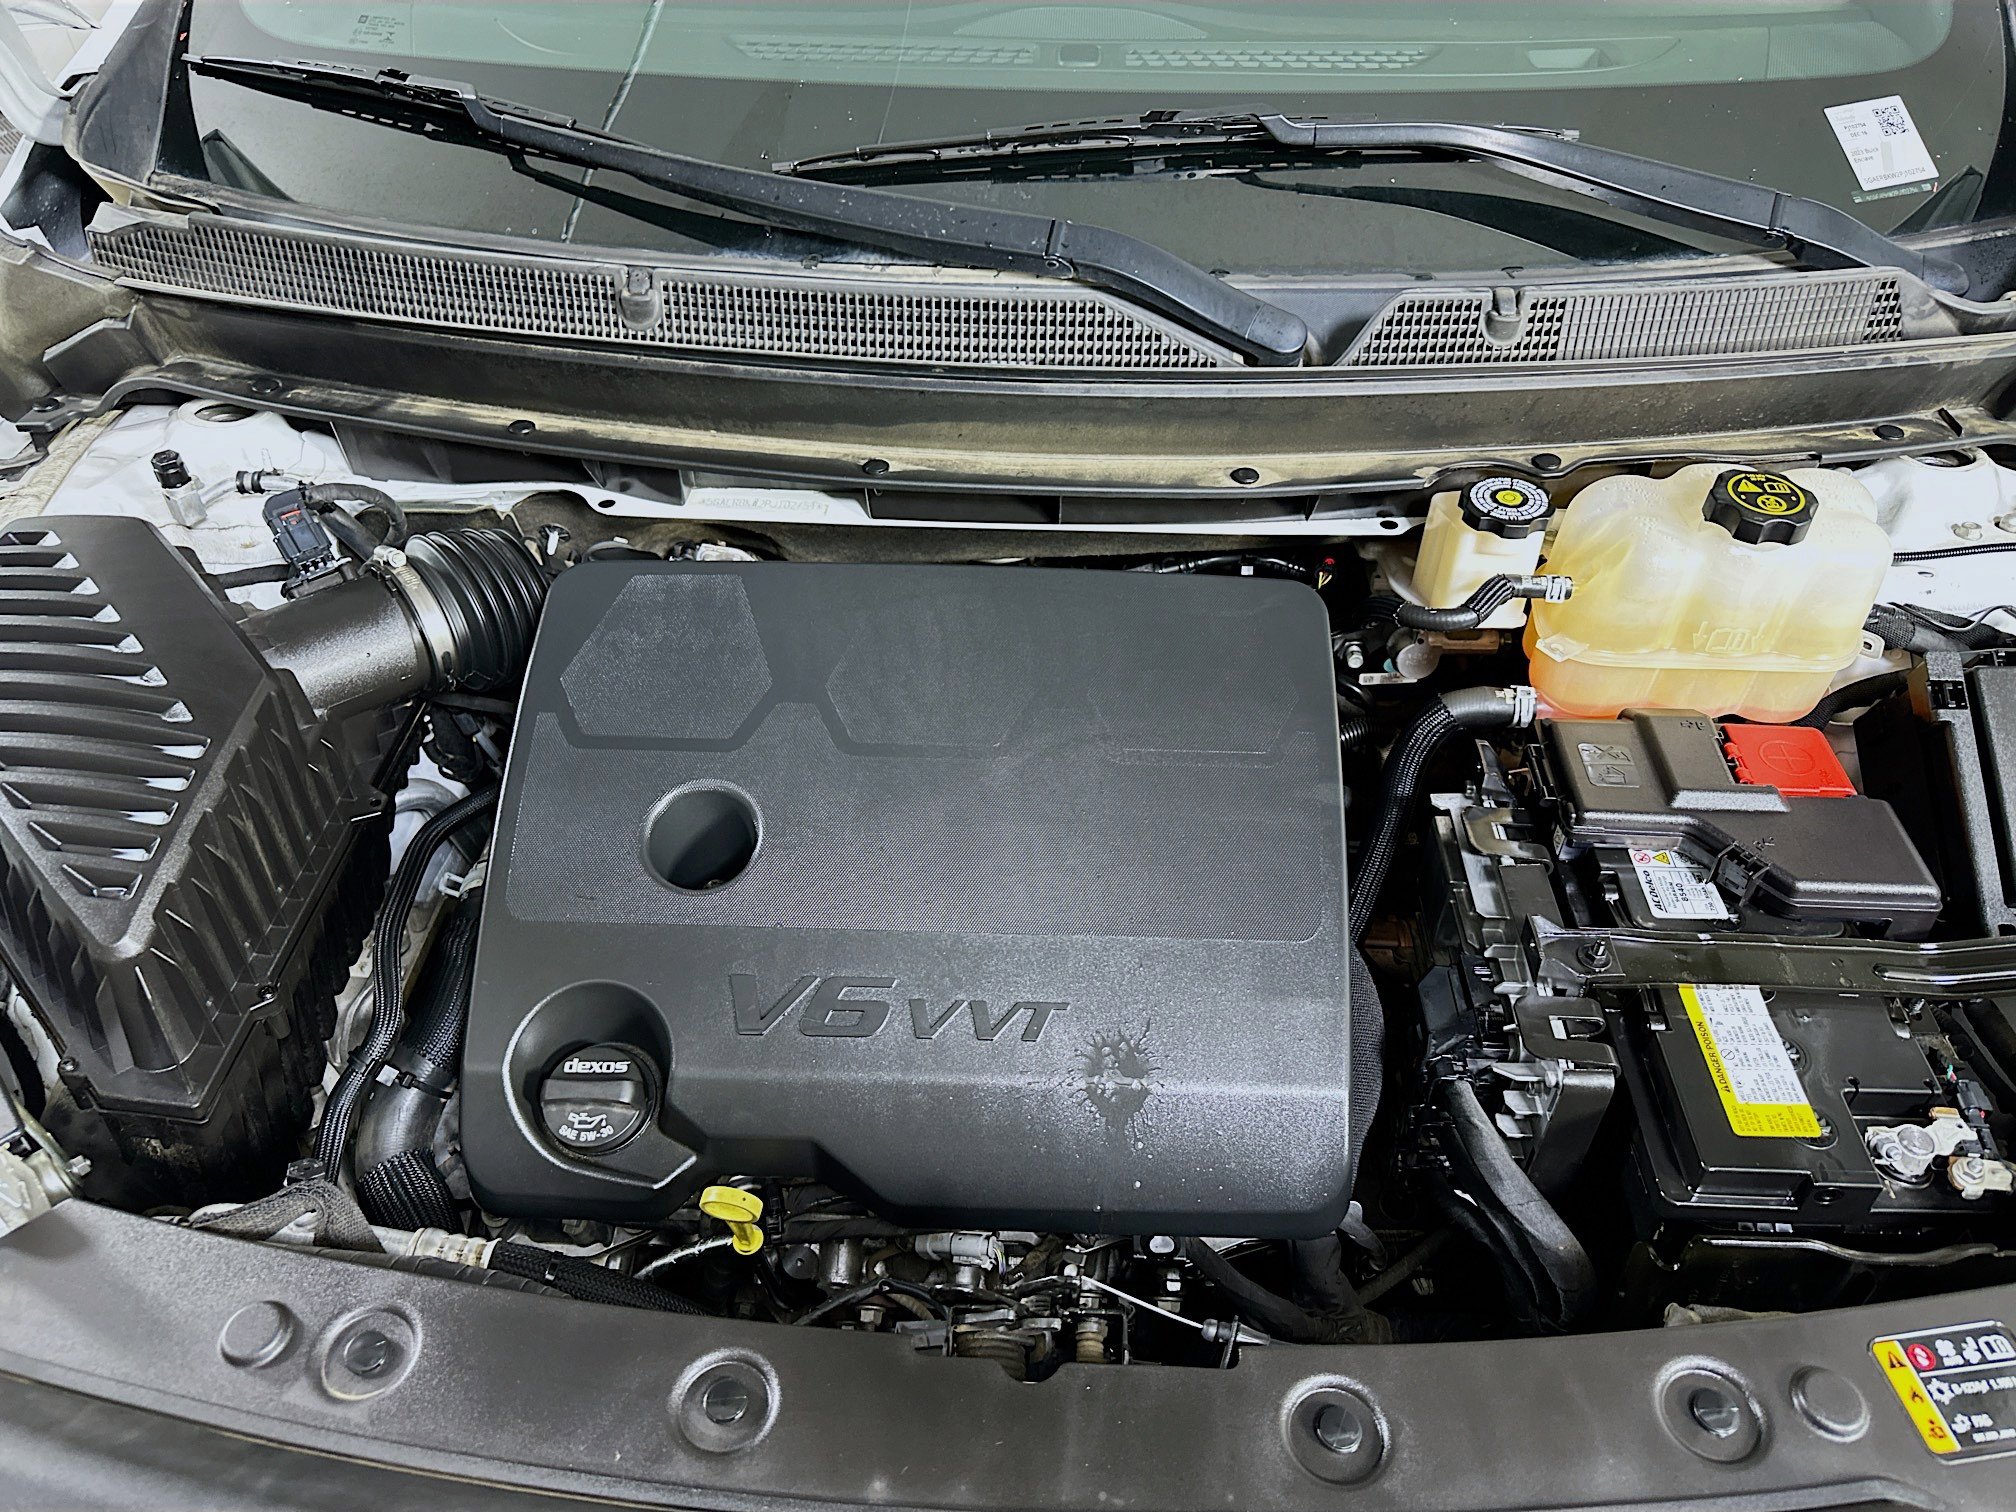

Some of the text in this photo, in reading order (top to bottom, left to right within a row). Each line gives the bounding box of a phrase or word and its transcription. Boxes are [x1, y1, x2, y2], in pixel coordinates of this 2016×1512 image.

[1643, 870, 1664, 911] ACDelco
[1676, 883, 1689, 902] 8540
[729, 973, 1071, 1042] V6 VVT
[563, 1057, 631, 1074] dexos
[1695, 1021, 1727, 1085] DANGER POISON
[558, 1124, 614, 1142] SAE 5W-30
